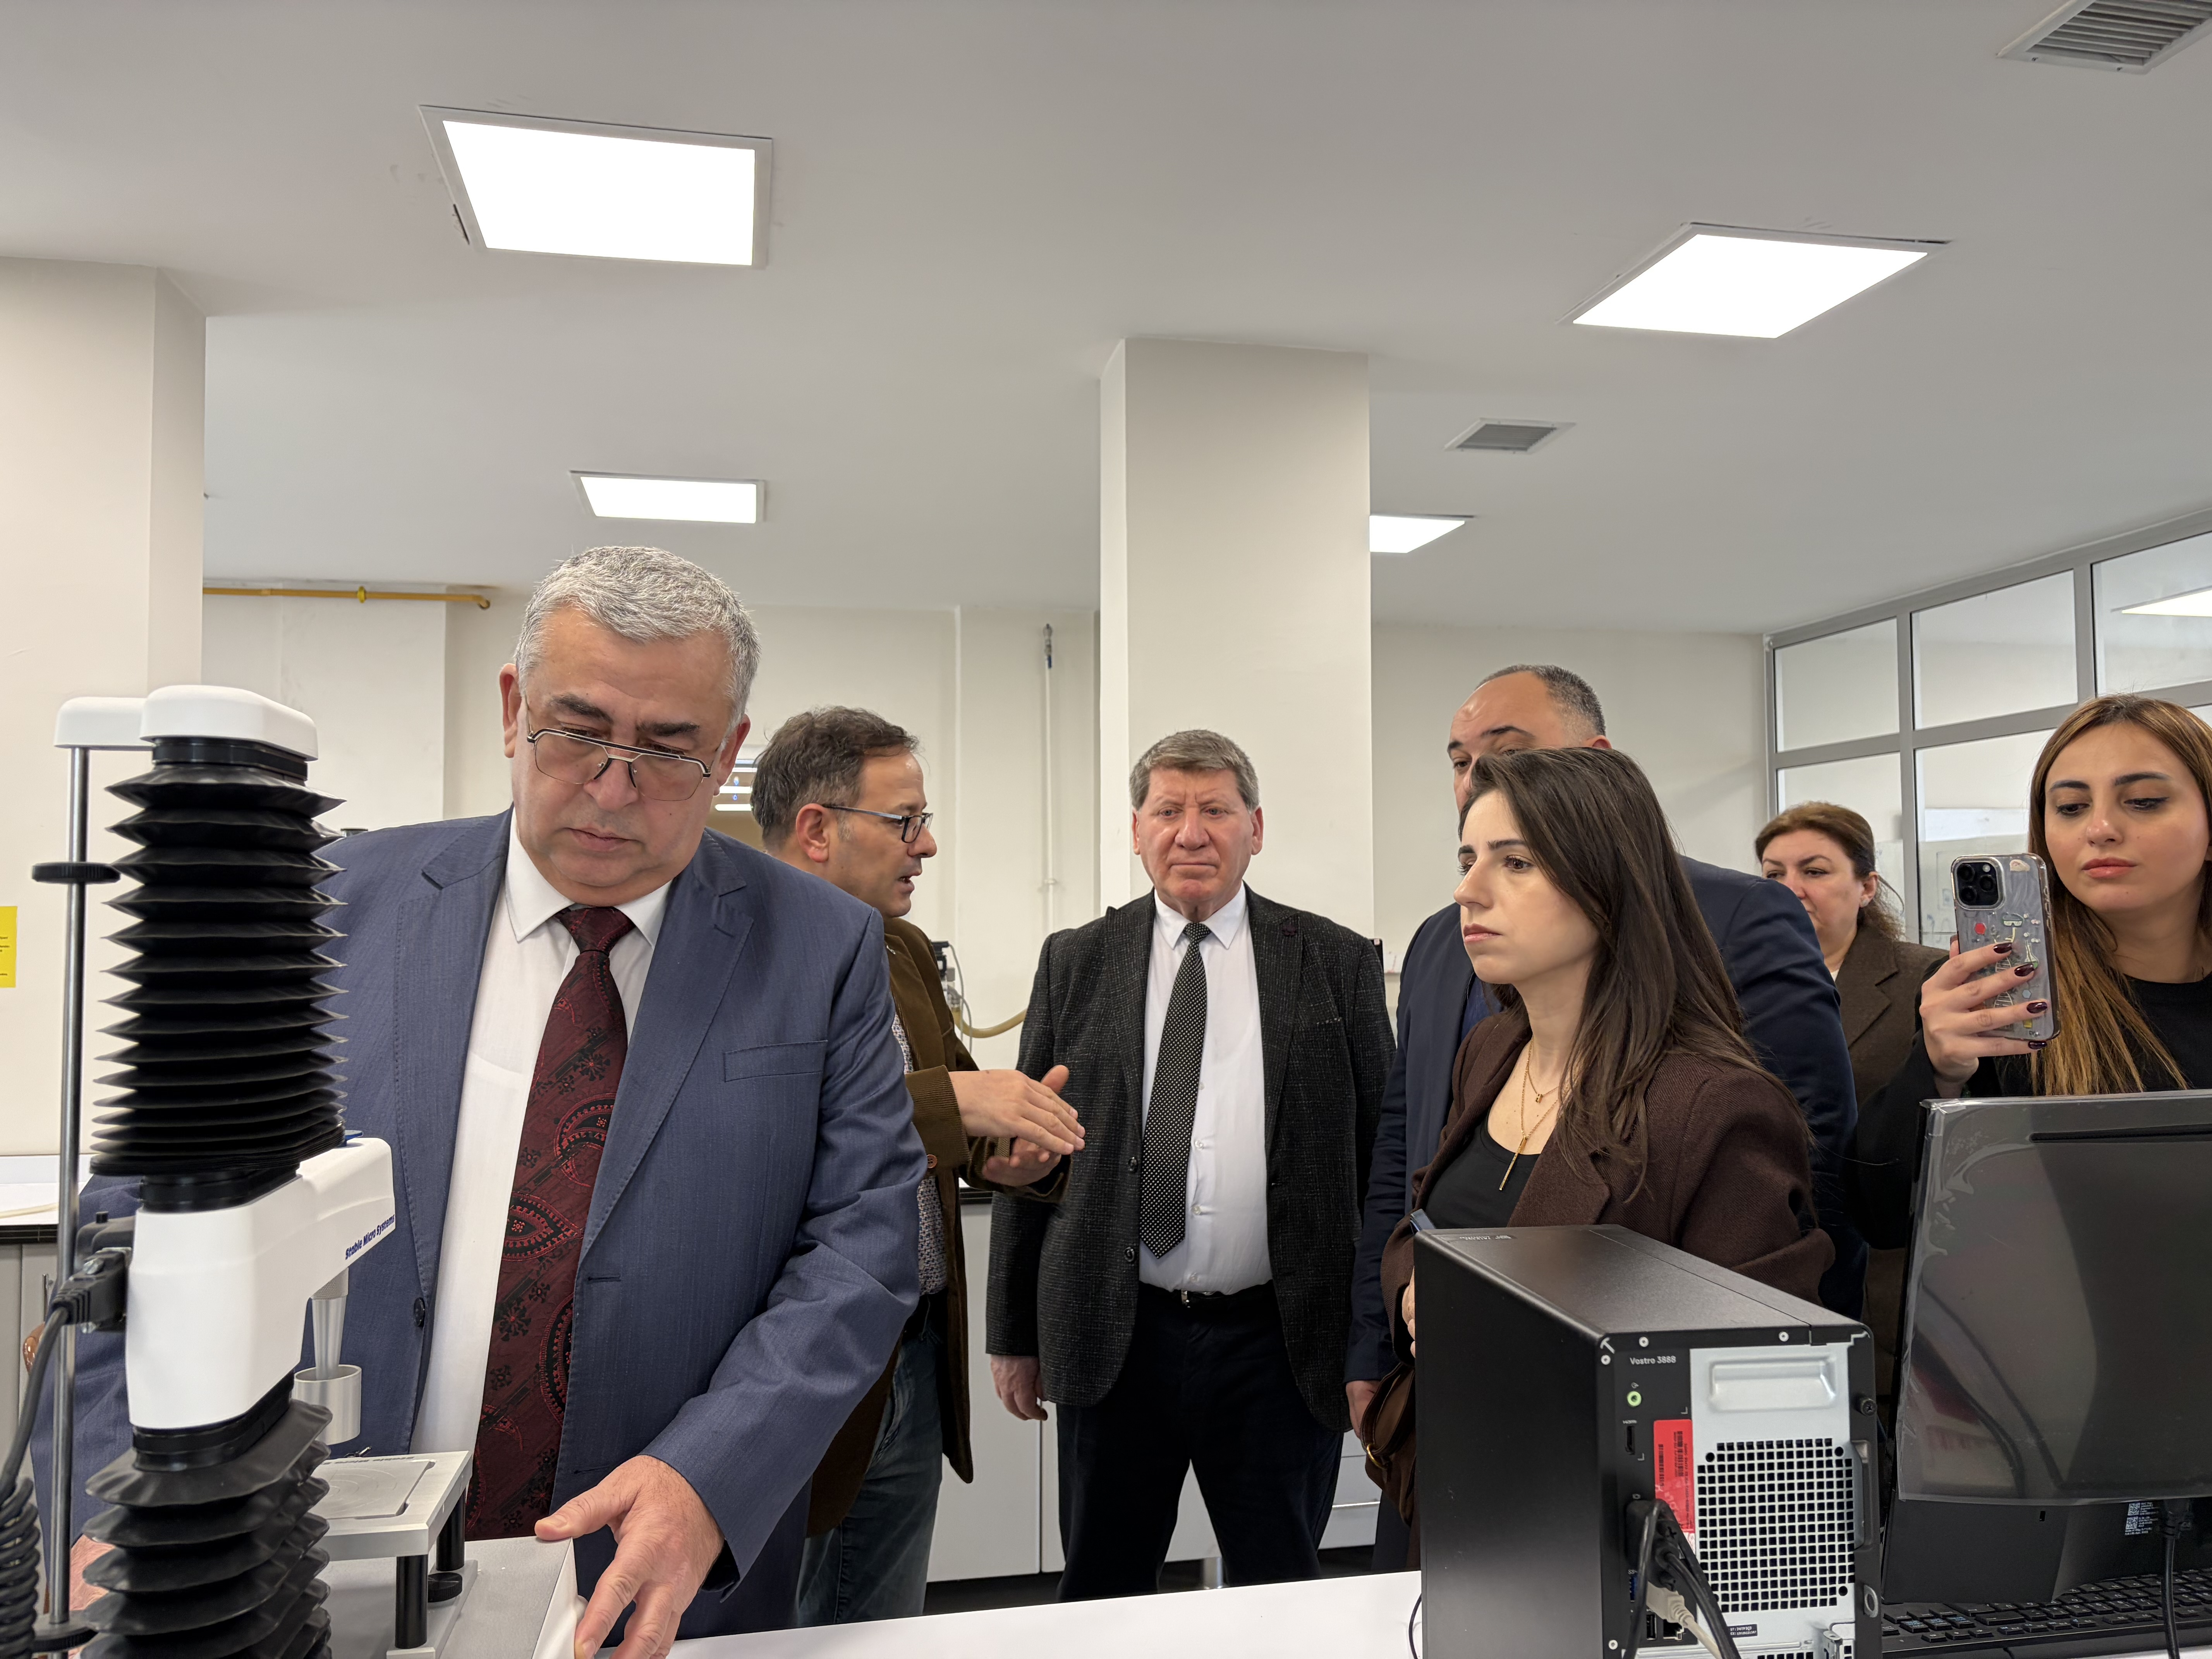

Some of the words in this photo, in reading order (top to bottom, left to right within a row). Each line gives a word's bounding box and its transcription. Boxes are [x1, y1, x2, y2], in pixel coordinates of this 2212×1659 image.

[345, 1240, 362, 1260] Stable
[363, 1232, 376, 1246] Micro
[377, 1214, 395, 1235] Systems
[1657, 1355, 1676, 1364] 3888
